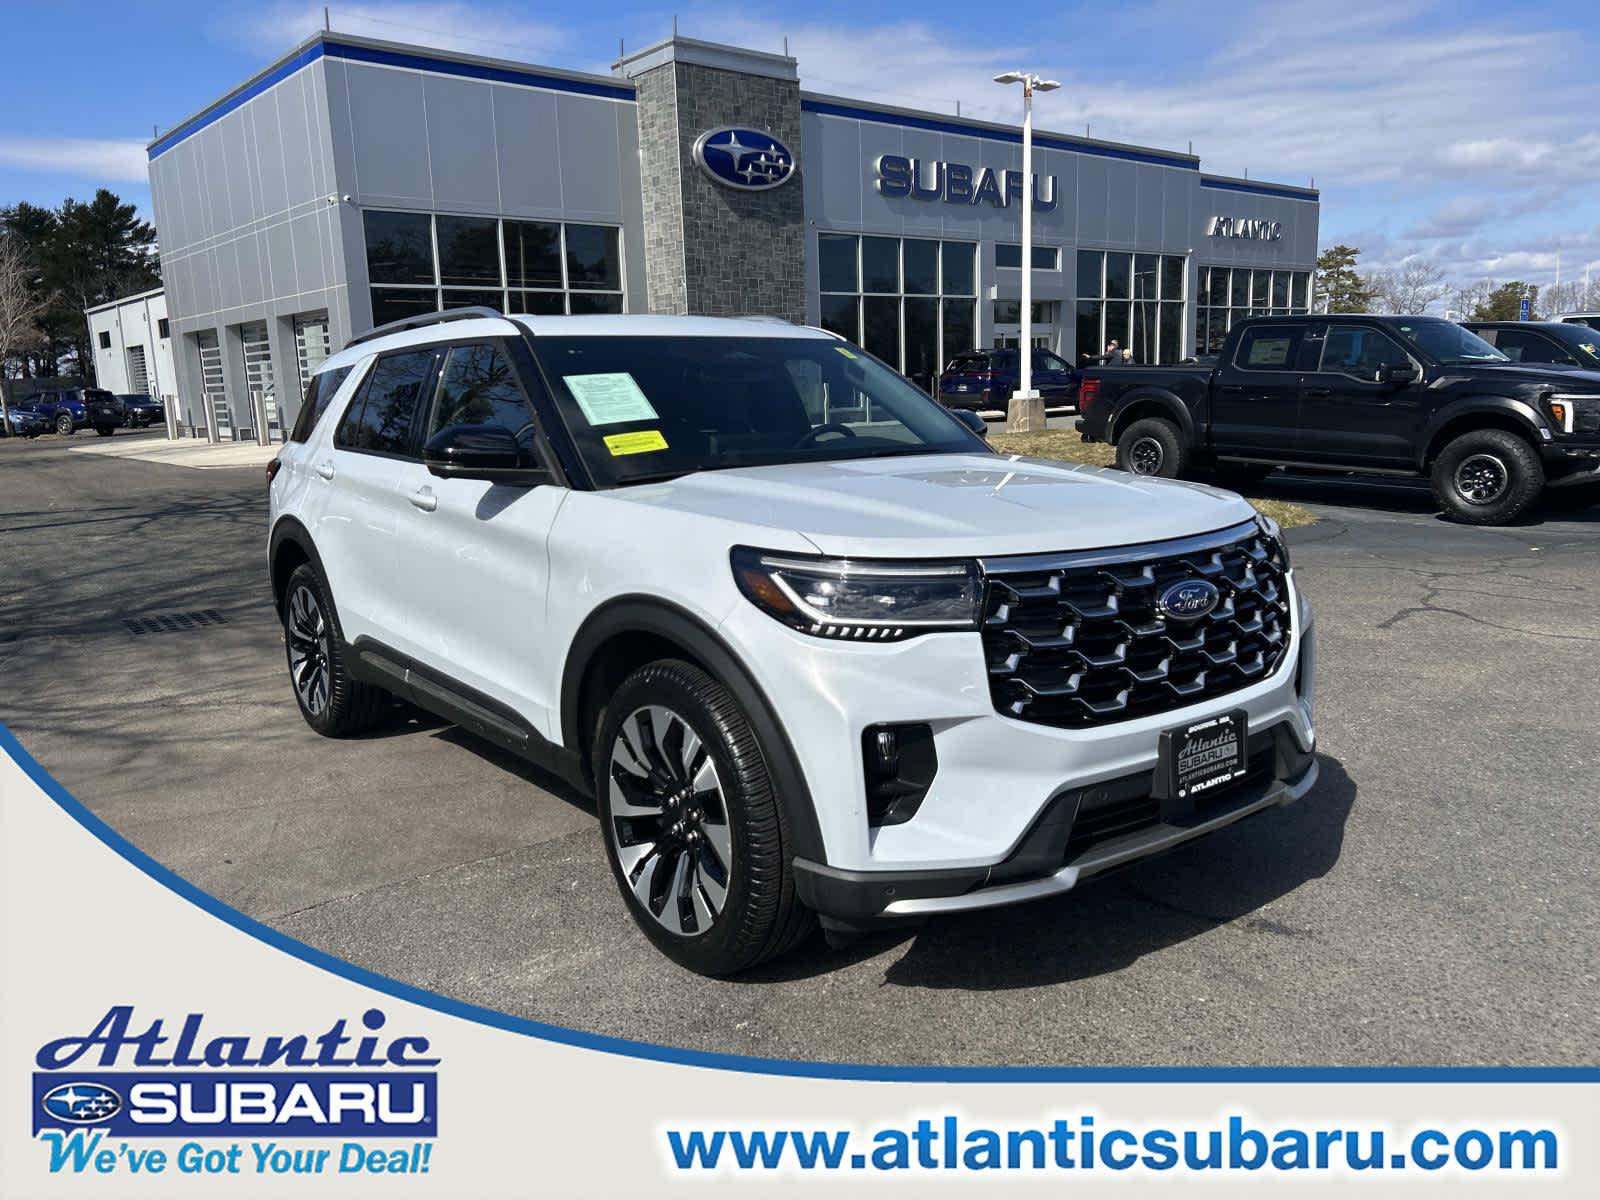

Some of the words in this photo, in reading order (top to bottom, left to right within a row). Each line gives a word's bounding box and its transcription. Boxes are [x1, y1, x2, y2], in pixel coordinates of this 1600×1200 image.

[876, 154, 1059, 212] SUBARU
[1208, 215, 1282, 242] ATLANTIC
[1174, 588, 1209, 611] Ford
[1178, 729, 1237, 760] Atlantic
[1179, 748, 1224, 771] SUBARU
[1190, 773, 1232, 794] ATLANTIC
